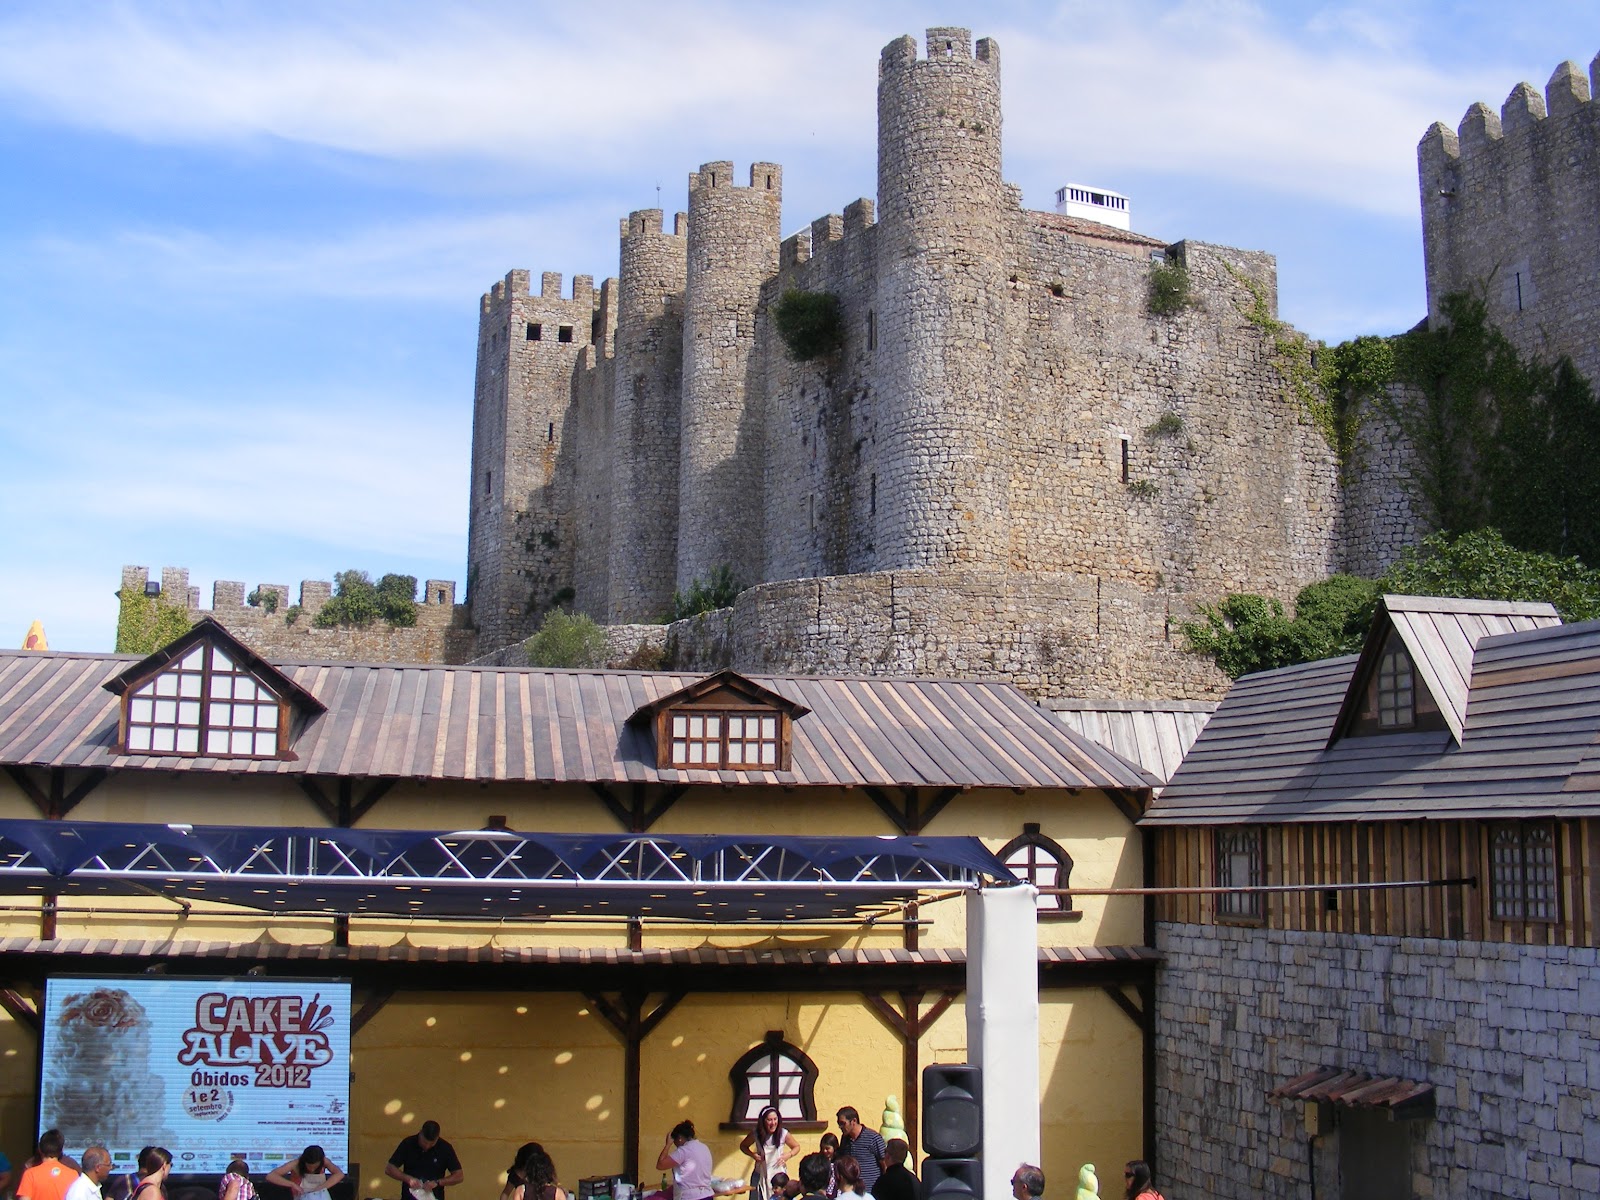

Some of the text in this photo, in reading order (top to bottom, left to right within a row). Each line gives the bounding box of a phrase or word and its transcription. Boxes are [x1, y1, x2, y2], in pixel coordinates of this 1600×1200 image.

[197, 994, 302, 1032] CAKE
[181, 1031, 330, 1065] ALIVE
[191, 1064, 310, 1087] Óbidos 2012
[189, 1089, 220, 1103] 1 e 2
[189, 1103, 223, 1112] setembro
